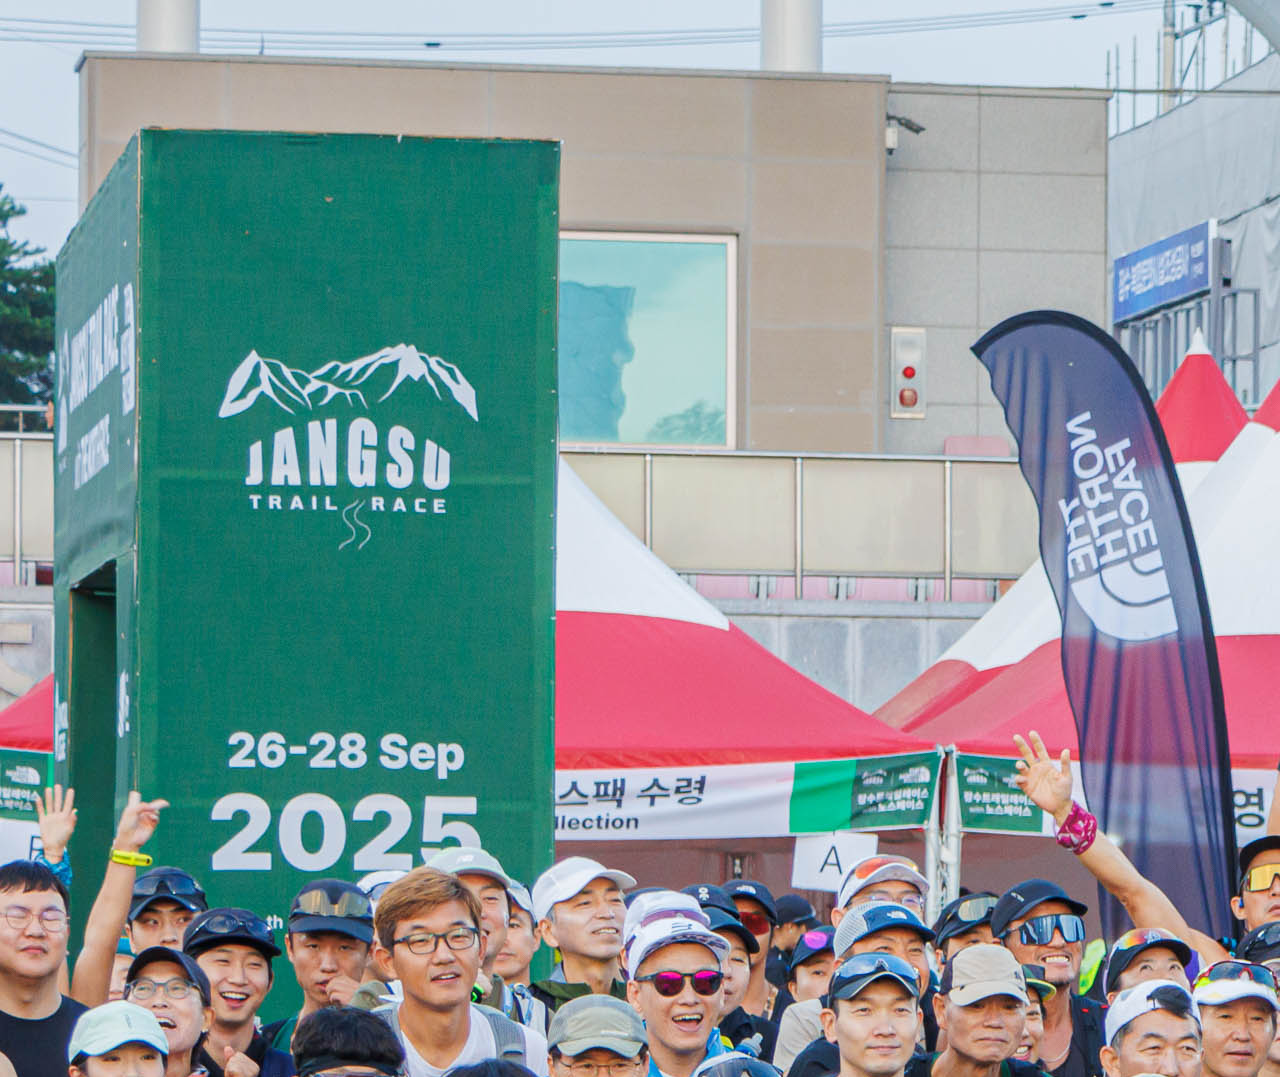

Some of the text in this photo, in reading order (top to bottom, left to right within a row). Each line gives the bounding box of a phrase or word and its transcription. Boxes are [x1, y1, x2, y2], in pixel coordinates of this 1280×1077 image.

[245, 418, 451, 491] JANGSU
[249, 494, 447, 514] TRAIL RACE
[228, 731, 465, 780] 26-28 Sep
[637, 775, 707, 807] 수령
[211, 792, 482, 872] 2025
[556, 814, 640, 831] llection
[819, 844, 843, 875] A
